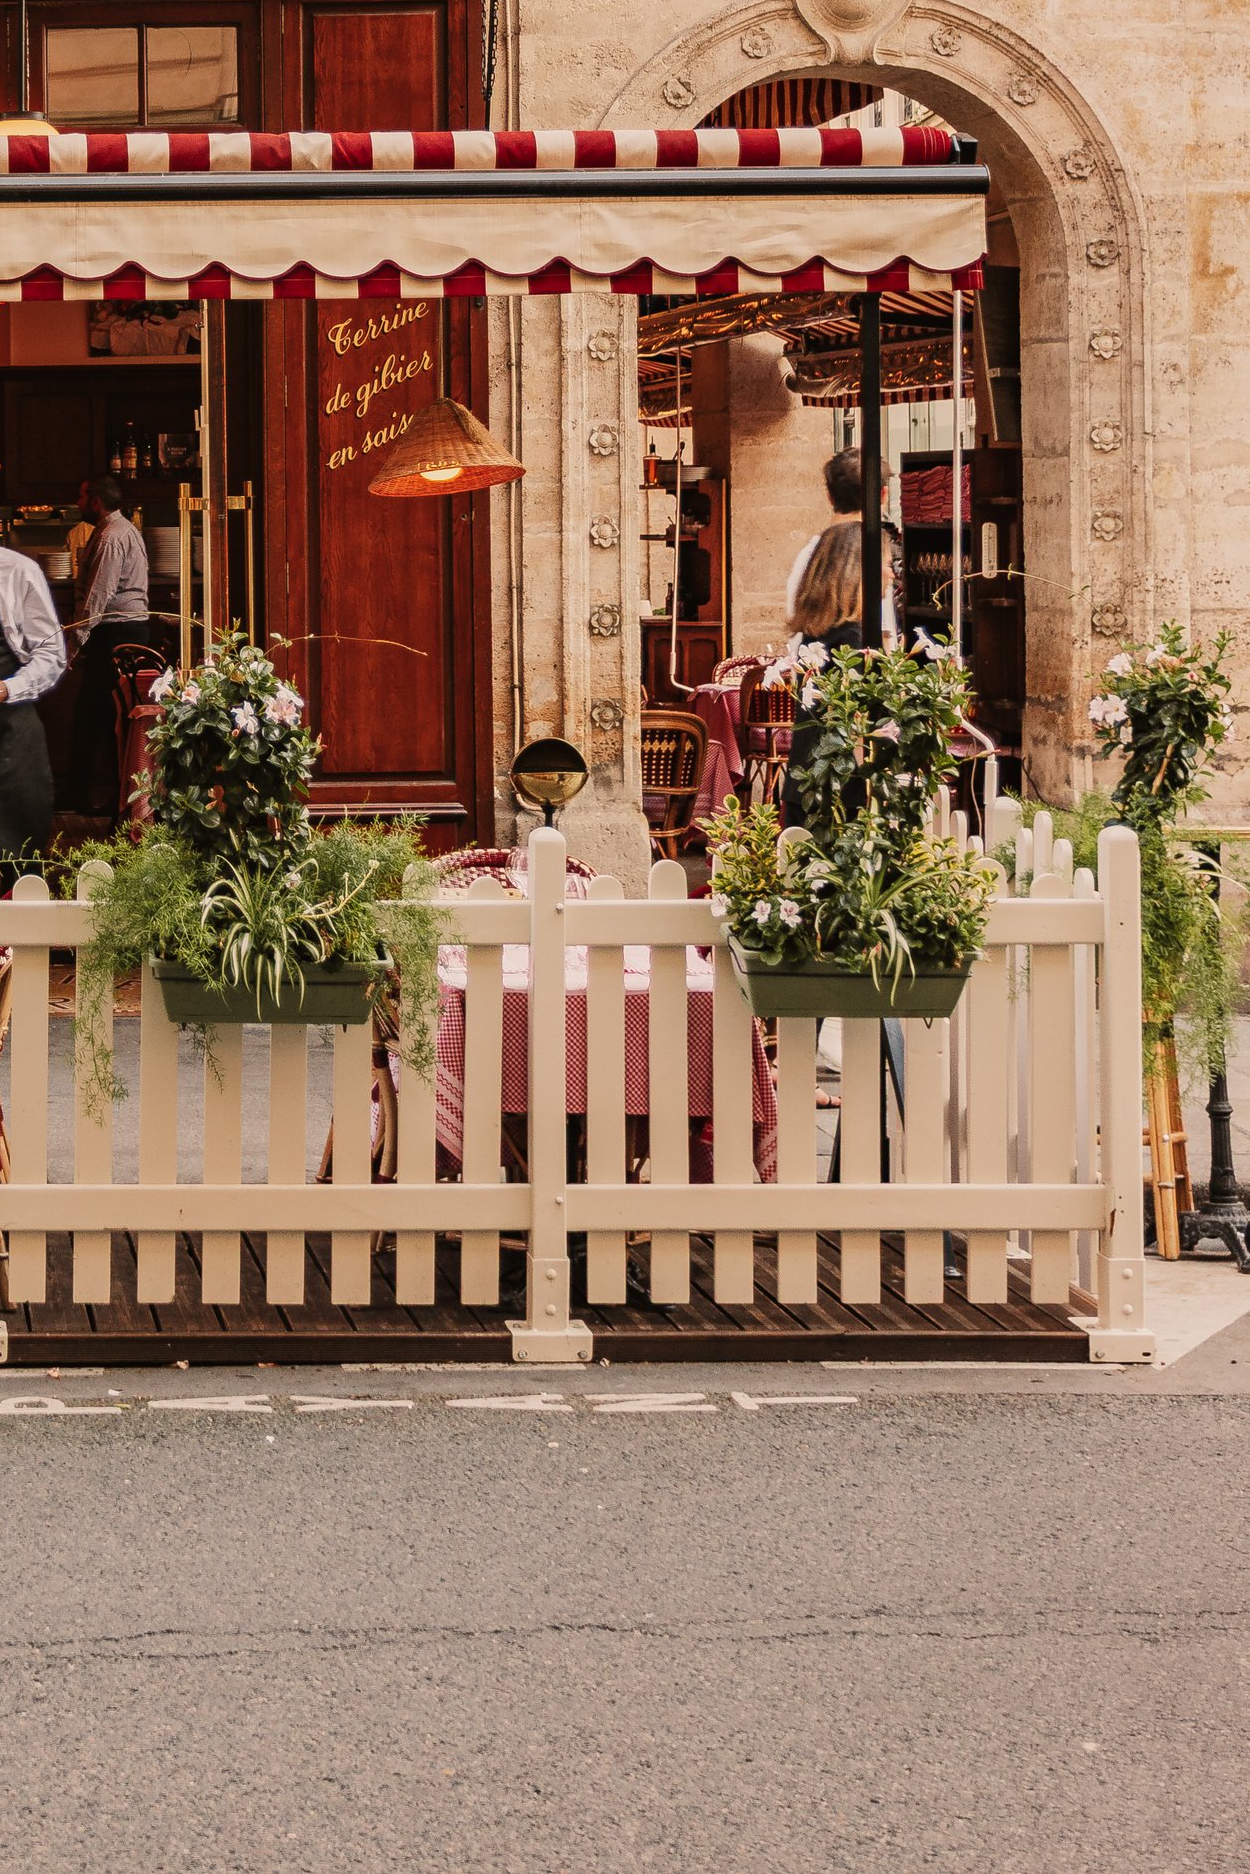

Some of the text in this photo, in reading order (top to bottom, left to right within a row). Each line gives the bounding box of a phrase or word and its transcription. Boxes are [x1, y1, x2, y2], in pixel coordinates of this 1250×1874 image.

[328, 301, 429, 355] Terrine
[326, 350, 433, 418] de gibier
[326, 411, 414, 469] en sais
